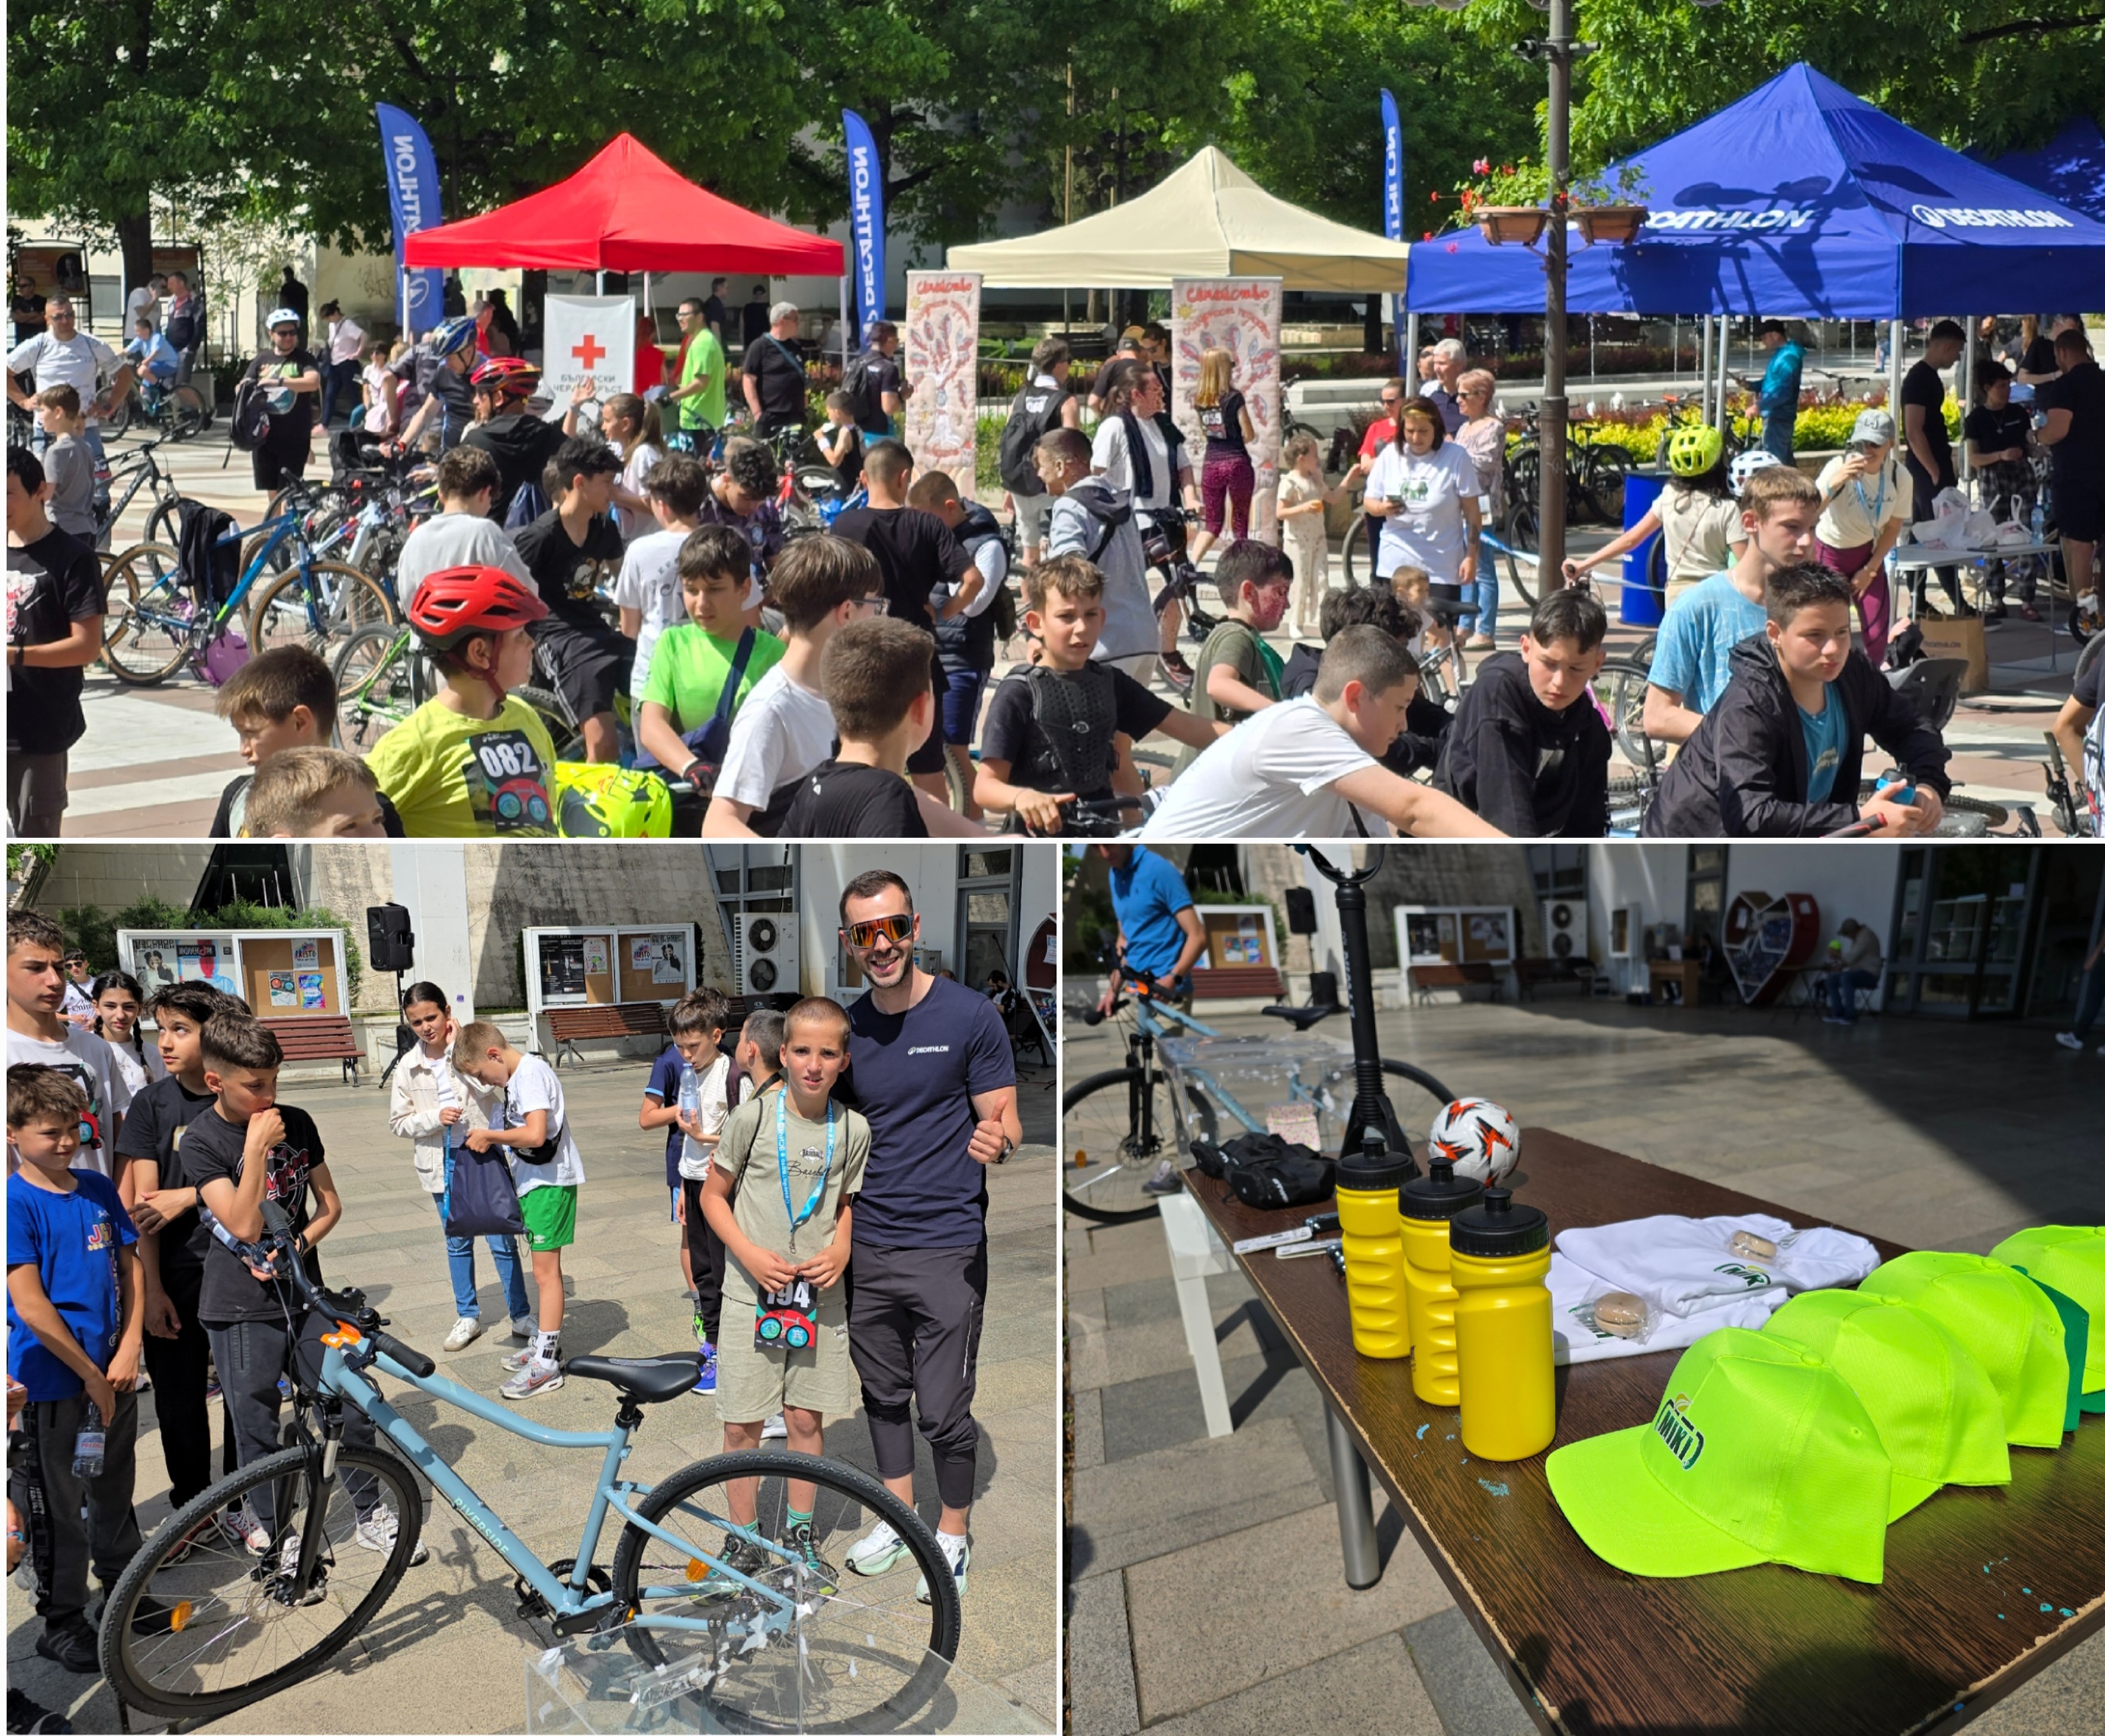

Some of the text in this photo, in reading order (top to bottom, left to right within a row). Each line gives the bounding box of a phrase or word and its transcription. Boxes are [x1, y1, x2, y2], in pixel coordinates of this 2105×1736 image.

[1645, 210, 1814, 230] CATHLON
[1934, 208, 2074, 227] DECATHLON
[479, 741, 539, 778] 082
[916, 1045, 949, 1053] DECATHLON
[1722, 1267, 1765, 1287] MIK
[453, 1497, 509, 1553] RIVERSIDE
